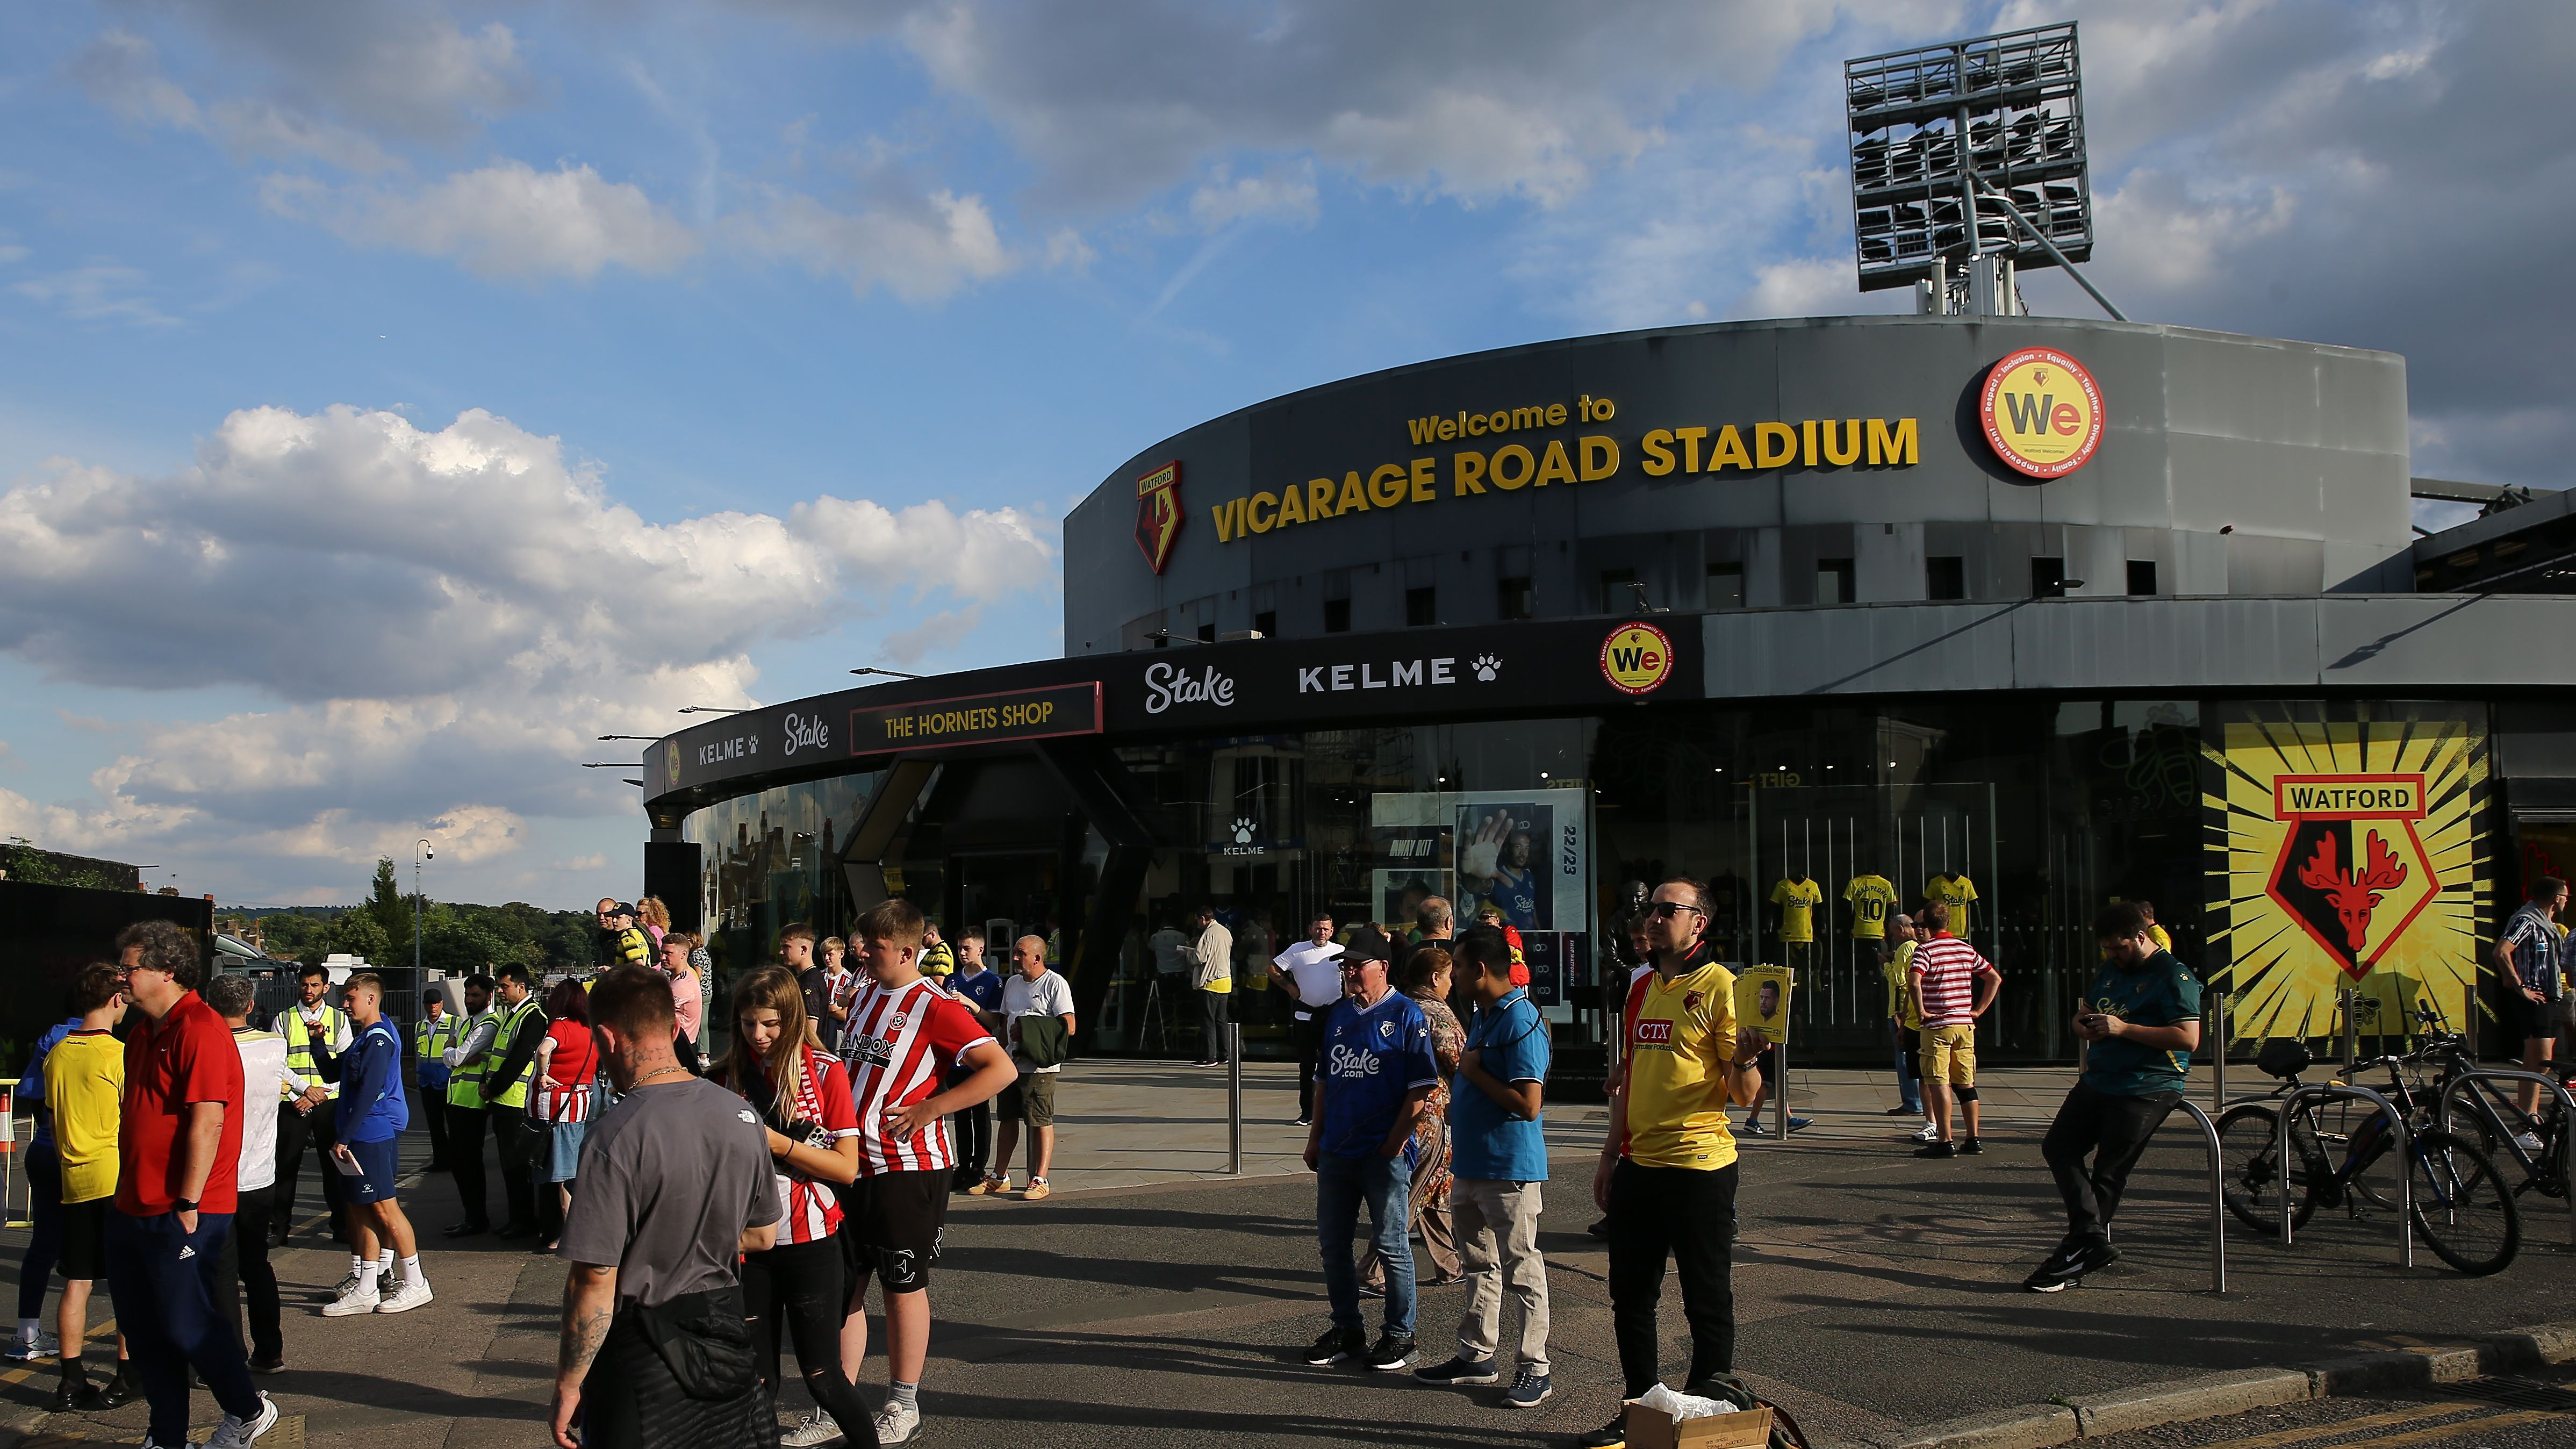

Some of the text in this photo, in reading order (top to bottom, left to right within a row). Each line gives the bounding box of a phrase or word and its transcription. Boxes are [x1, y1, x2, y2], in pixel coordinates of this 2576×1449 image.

[1408, 394, 1615, 444] Welcome to
[1985, 353, 2100, 473] Inclusion Equality Together Diversity Family Empowerment Respect
[2004, 393, 2081, 436] We
[1141, 470, 1171, 493] WATFORD
[1212, 418, 1918, 543] VICARAGE ROAD STADIUM
[1612, 647, 1660, 672] We
[1145, 663, 1235, 714] Stake
[1300, 658, 1455, 693] KELME
[885, 702, 1053, 738] THE HORNETS SHOP
[785, 713, 828, 756] Stake
[700, 737, 744, 766] KELME
[2291, 788, 2409, 809] WATFORD
[1224, 847, 1264, 856] KELME
[1415, 839, 1434, 856] KIT
[1563, 826, 1577, 876] 22/23
[1788, 895, 1810, 907] Stake
[1860, 898, 1884, 921] 10
[1638, 1023, 1670, 1039] CTX
[841, 1033, 897, 1058] ANDOX
[848, 1050, 873, 1062] HEALTH
[1331, 1044, 1379, 1075] Stake
[179, 1251, 195, 1260] adidas
